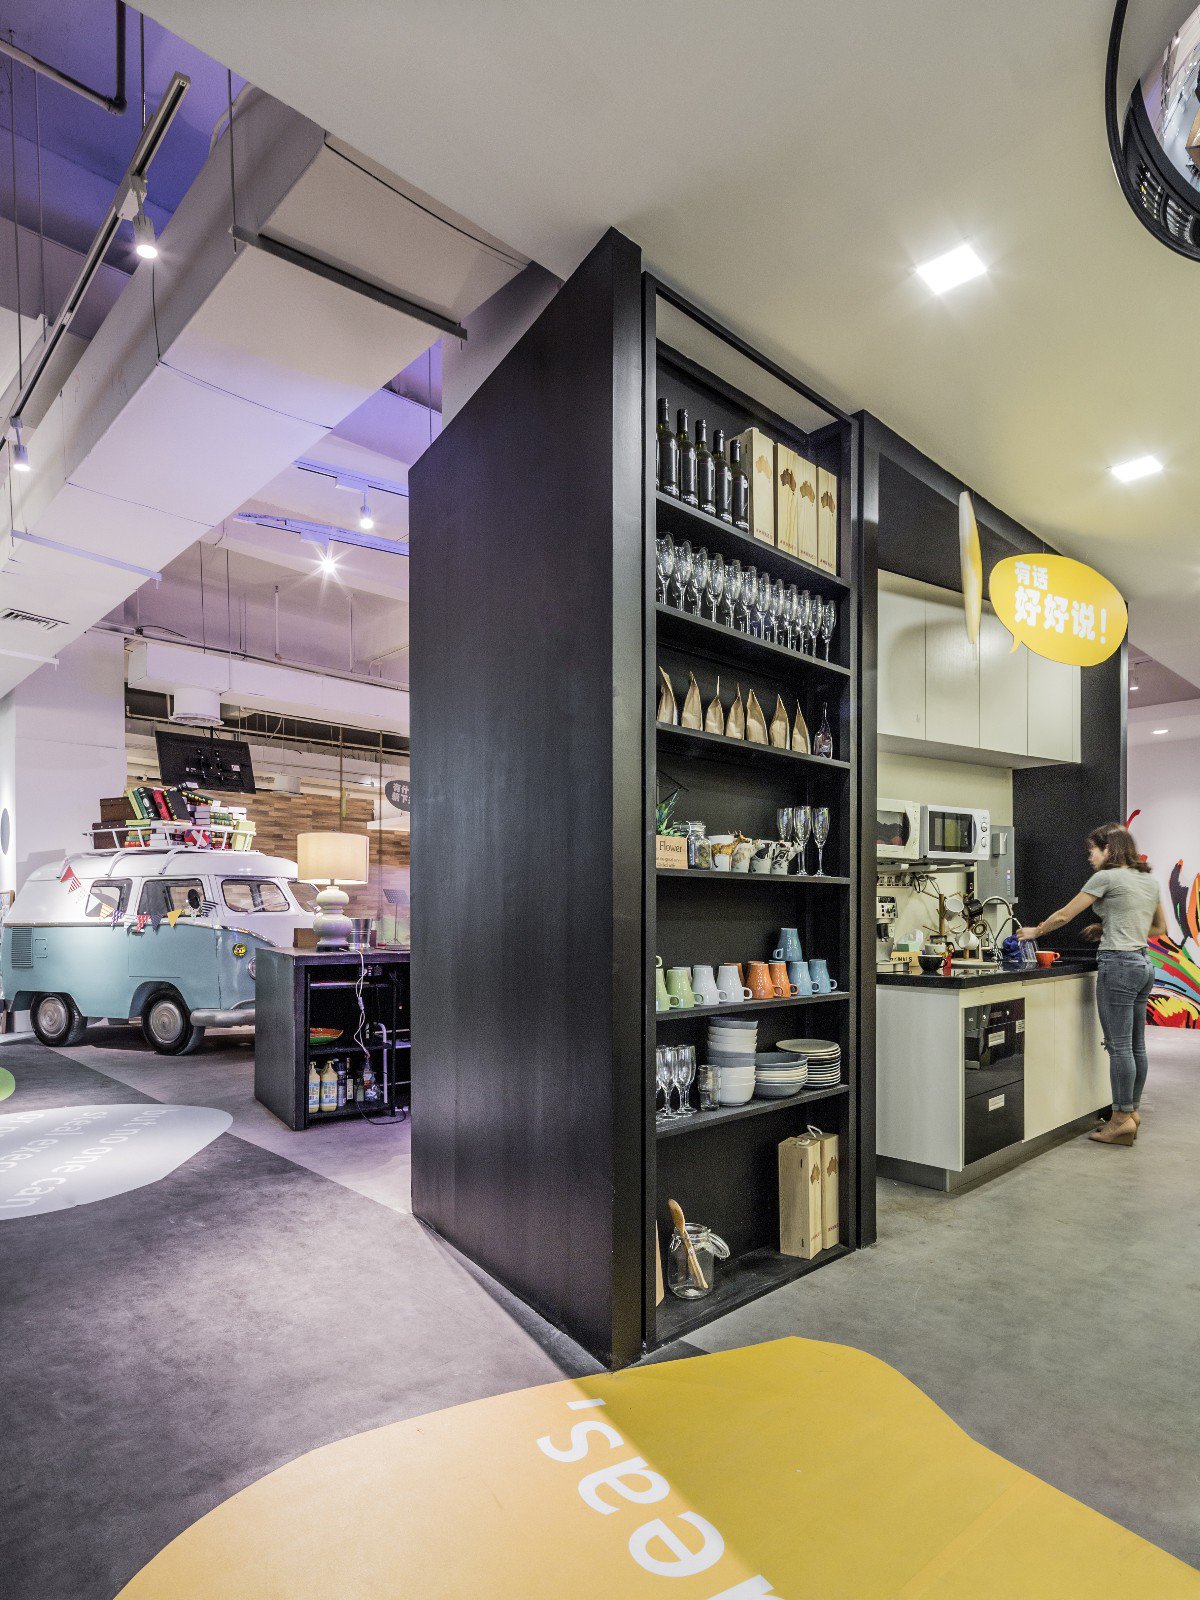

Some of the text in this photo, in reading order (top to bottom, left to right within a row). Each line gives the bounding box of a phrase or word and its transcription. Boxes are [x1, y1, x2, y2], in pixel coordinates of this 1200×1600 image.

[1014, 561, 1048, 590] 有话
[392, 783, 410, 794] 有什
[659, 841, 683, 853] Flower
[0, 1111, 108, 1173] steal exec
[0, 1108, 181, 1208] but no one can
[536, 1398, 785, 1600] eas,
